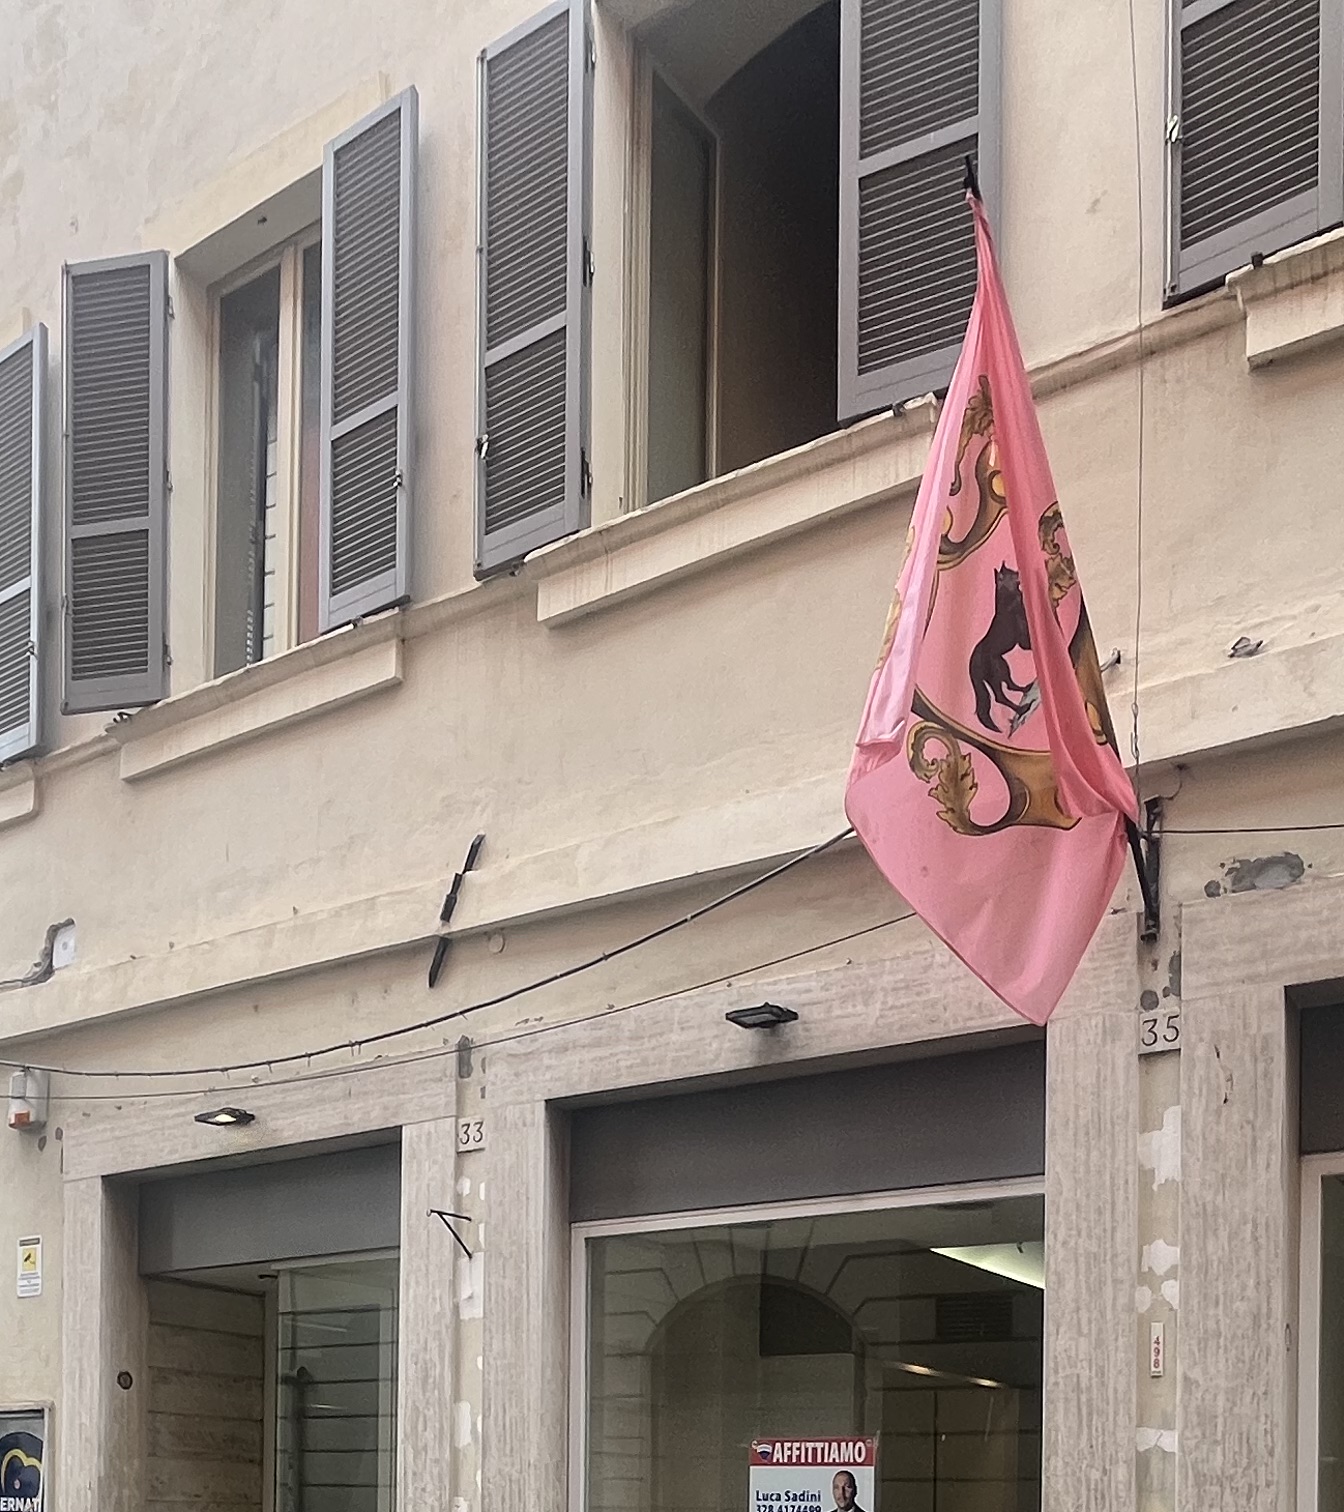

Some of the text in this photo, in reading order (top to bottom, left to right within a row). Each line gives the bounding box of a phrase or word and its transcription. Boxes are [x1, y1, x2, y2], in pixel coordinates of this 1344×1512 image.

[1141, 1014, 1180, 1046] 35
[459, 1120, 484, 1145] 33
[772, 1441, 866, 1463] AFFITTIAMO
[756, 1489, 821, 1502] Luca Sadini
